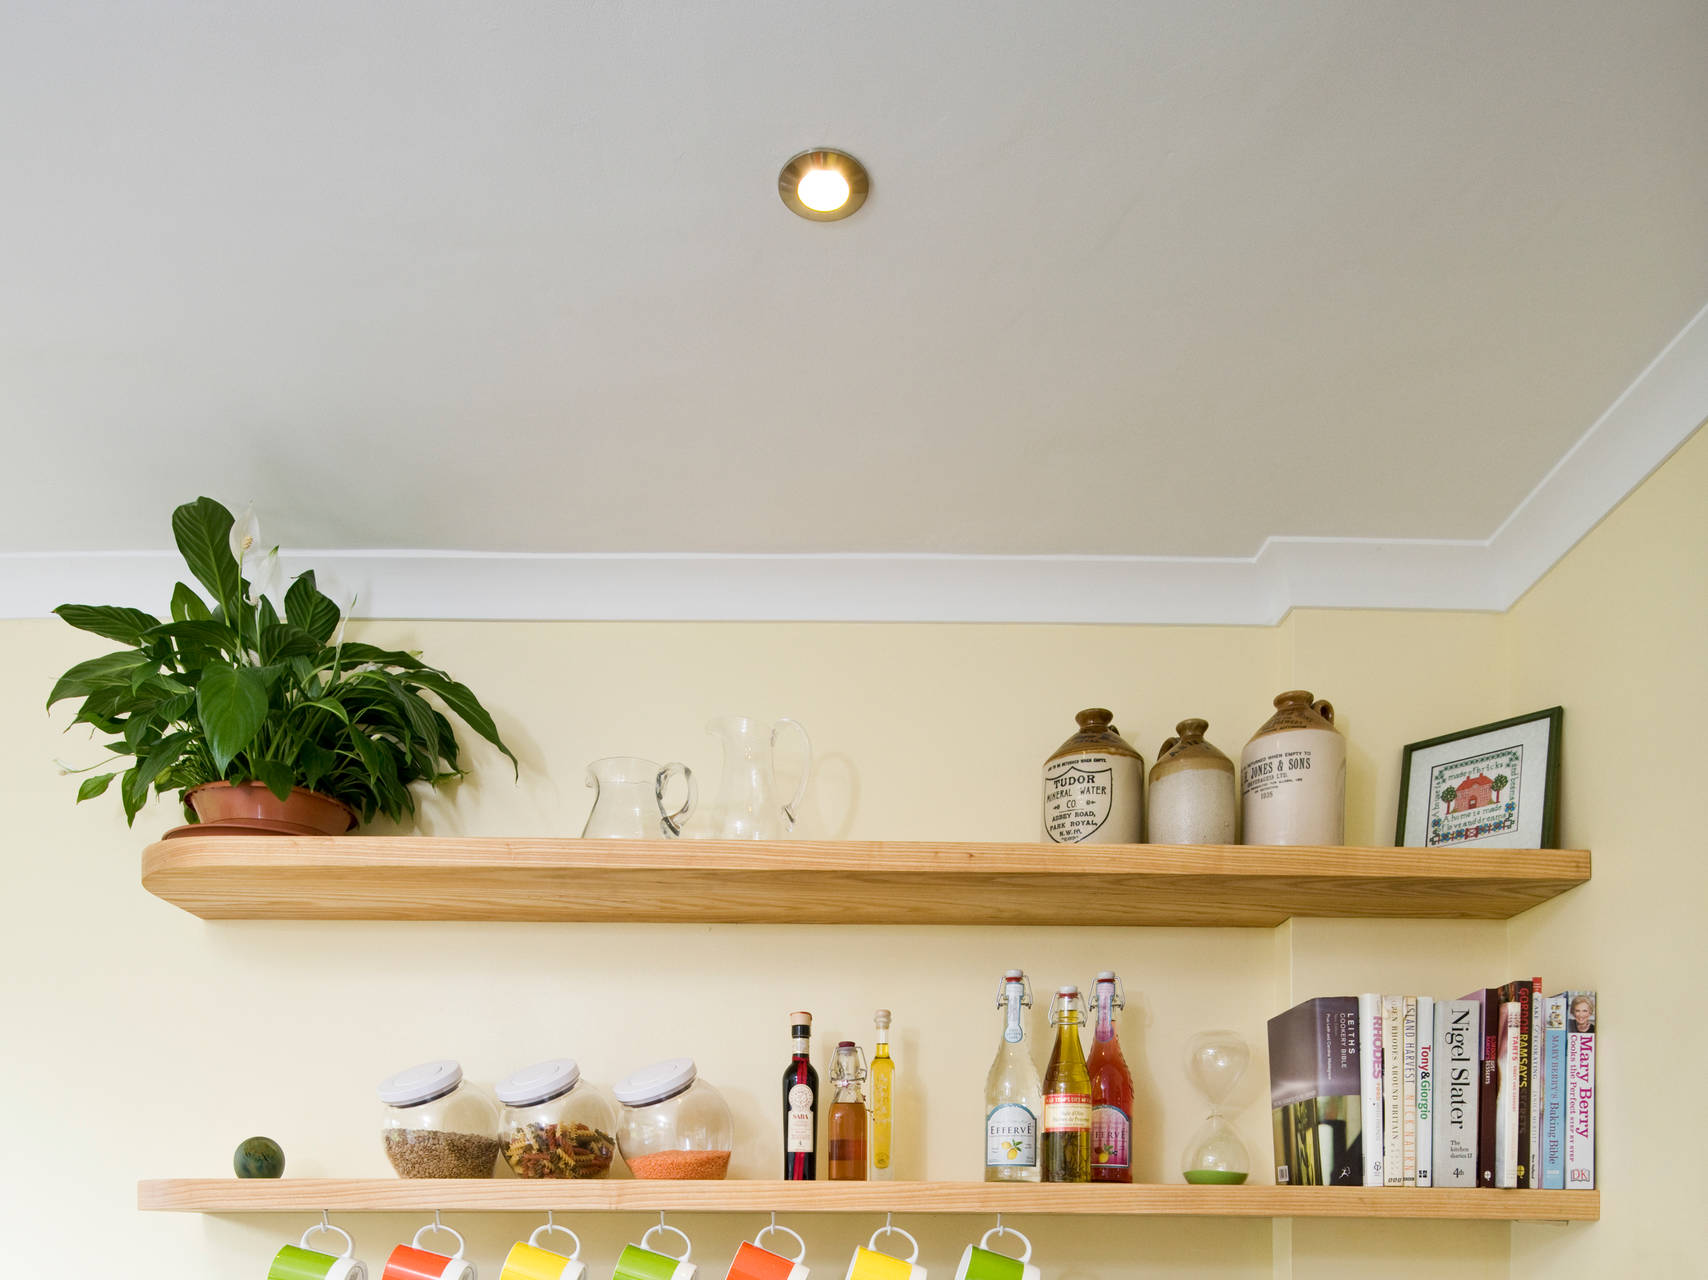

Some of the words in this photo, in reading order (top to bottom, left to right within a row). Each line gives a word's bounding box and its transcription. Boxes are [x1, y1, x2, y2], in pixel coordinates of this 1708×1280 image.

[1053, 774, 1096, 790] TUDOR
[1250, 761, 1273, 780] JONES
[1277, 759, 1284, 772] &
[1288, 757, 1312, 771] SONS
[1477, 761, 1504, 774] bricks
[1046, 788, 1073, 804] MINERAL
[1080, 785, 1107, 796] WATER
[1049, 822, 1066, 832] PARK
[1051, 812, 1072, 823] ABBEY
[1405, 1004, 1416, 1038] ISLAND
[1520, 987, 1529, 1034] GORDON
[1339, 1013, 1347, 1047] COOKERY
[1347, 1012, 1356, 1055] LEITHS
[1373, 1015, 1383, 1079] RHODES
[1391, 1025, 1399, 1060] RHODES
[1445, 1009, 1470, 1062] Nigel
[1551, 1035, 1560, 1059] MARY
[1340, 1048, 1348, 1069] BIBLE
[1404, 1042, 1415, 1083] HARVEST
[1511, 1035, 1519, 1061] TARTS
[1519, 1034, 1529, 1088] RAMSAY'S
[1576, 1035, 1593, 1083] Mary
[1391, 1065, 1399, 1101] AROUND
[1551, 1062, 1560, 1099] BERRY'S
[1404, 1095, 1415, 1124] NICK
[1450, 1067, 1470, 1130] Slater
[1569, 1082, 1577, 1114] Perfect
[1576, 1087, 1592, 1139] Berry
[1391, 1104, 1399, 1140] BRITAIN
[1548, 1102, 1560, 1138] Baking
[1548, 1140, 1559, 1164] Bible
[1453, 1167, 1464, 1178] 4th
[1572, 1168, 1588, 1180] DK
